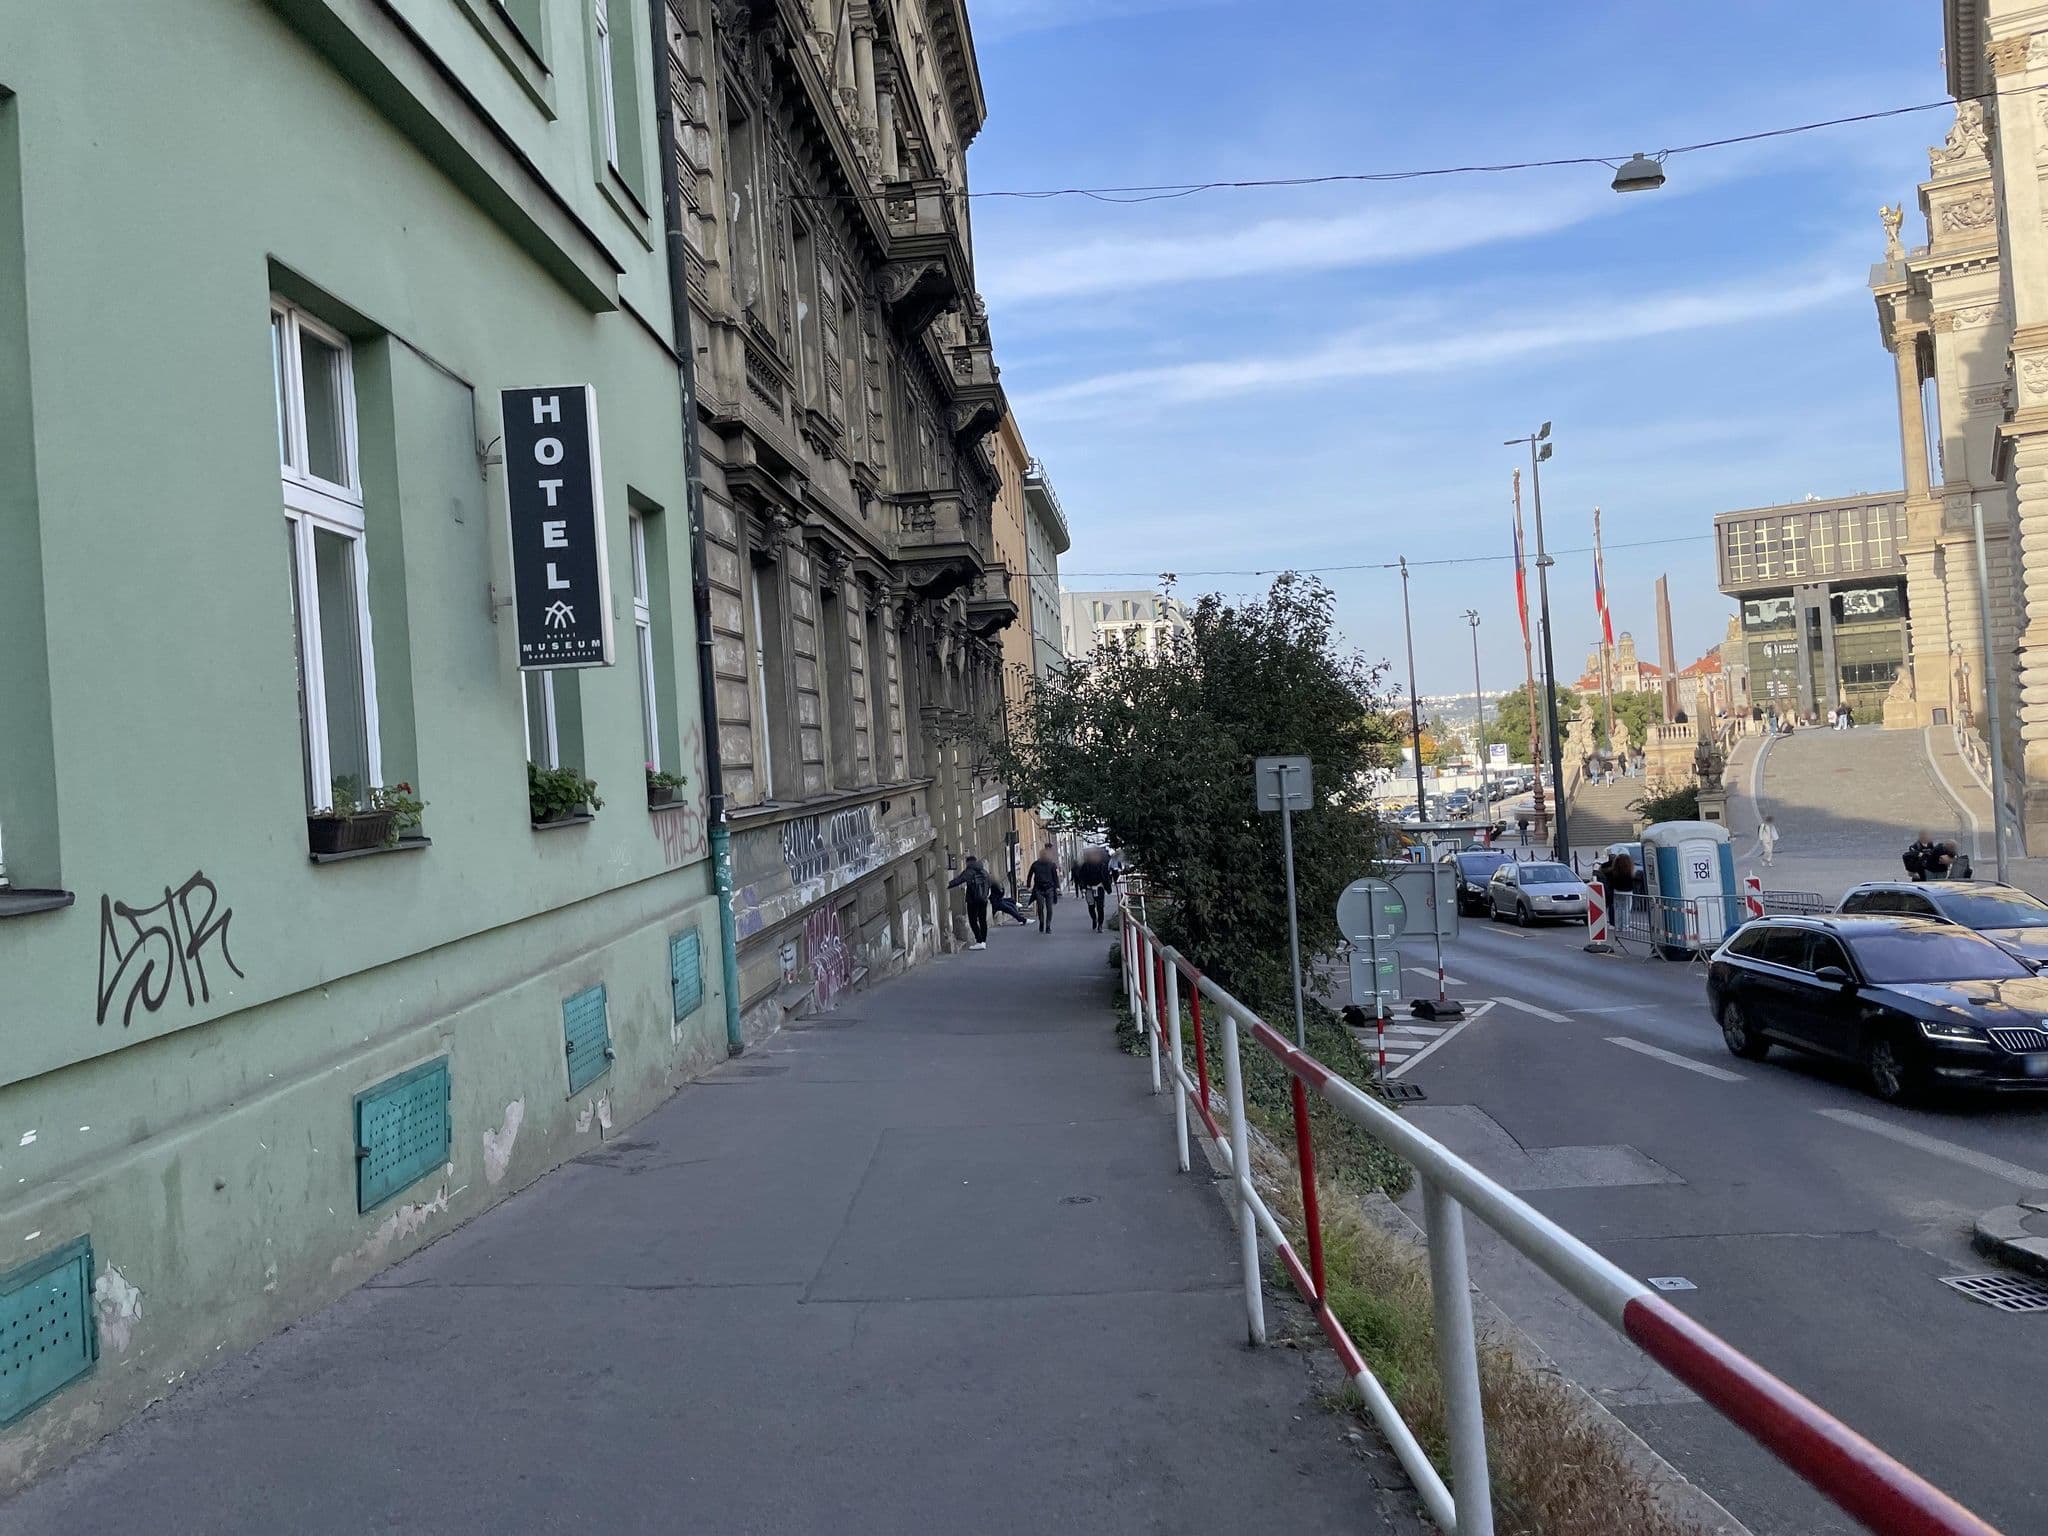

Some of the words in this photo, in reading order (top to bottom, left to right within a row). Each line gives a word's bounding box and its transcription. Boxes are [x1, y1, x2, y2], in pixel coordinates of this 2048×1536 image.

[532, 396, 570, 590] HOTEL
[523, 639, 601, 652] MUSEUM
[1693, 862, 1709, 871] TOI
[1694, 870, 1710, 879] TOI
